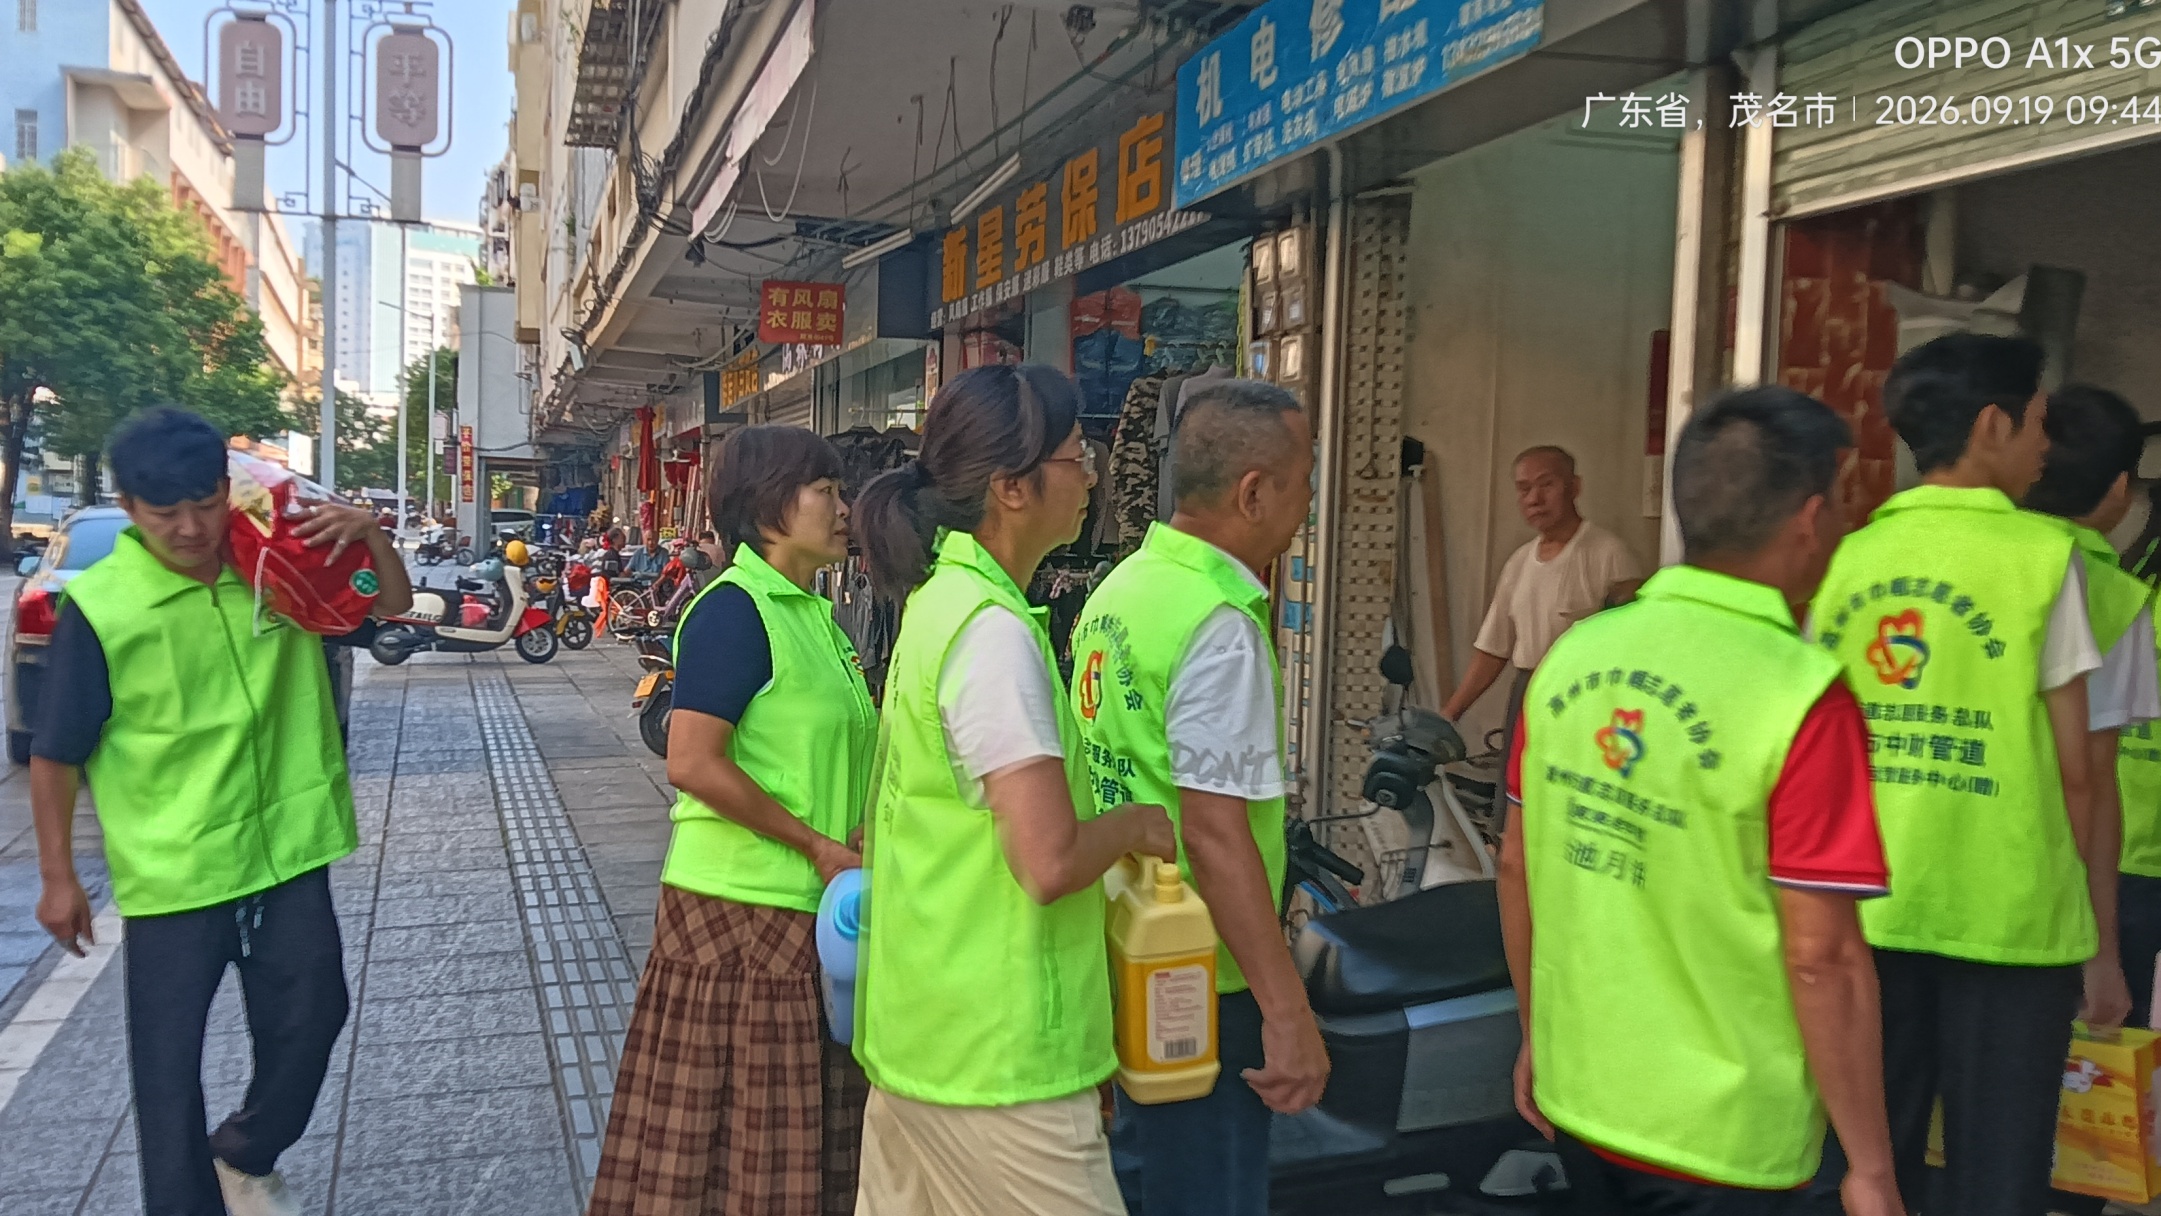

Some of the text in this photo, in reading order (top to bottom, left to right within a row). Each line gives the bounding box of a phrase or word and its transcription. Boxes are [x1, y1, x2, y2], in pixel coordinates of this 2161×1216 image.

[234, 40, 267, 117] 自由
[388, 52, 428, 127] 平等
[941, 111, 1165, 303] 新星劳保店
[767, 309, 838, 332] 衣服卖
[768, 287, 838, 310] 有风扇
